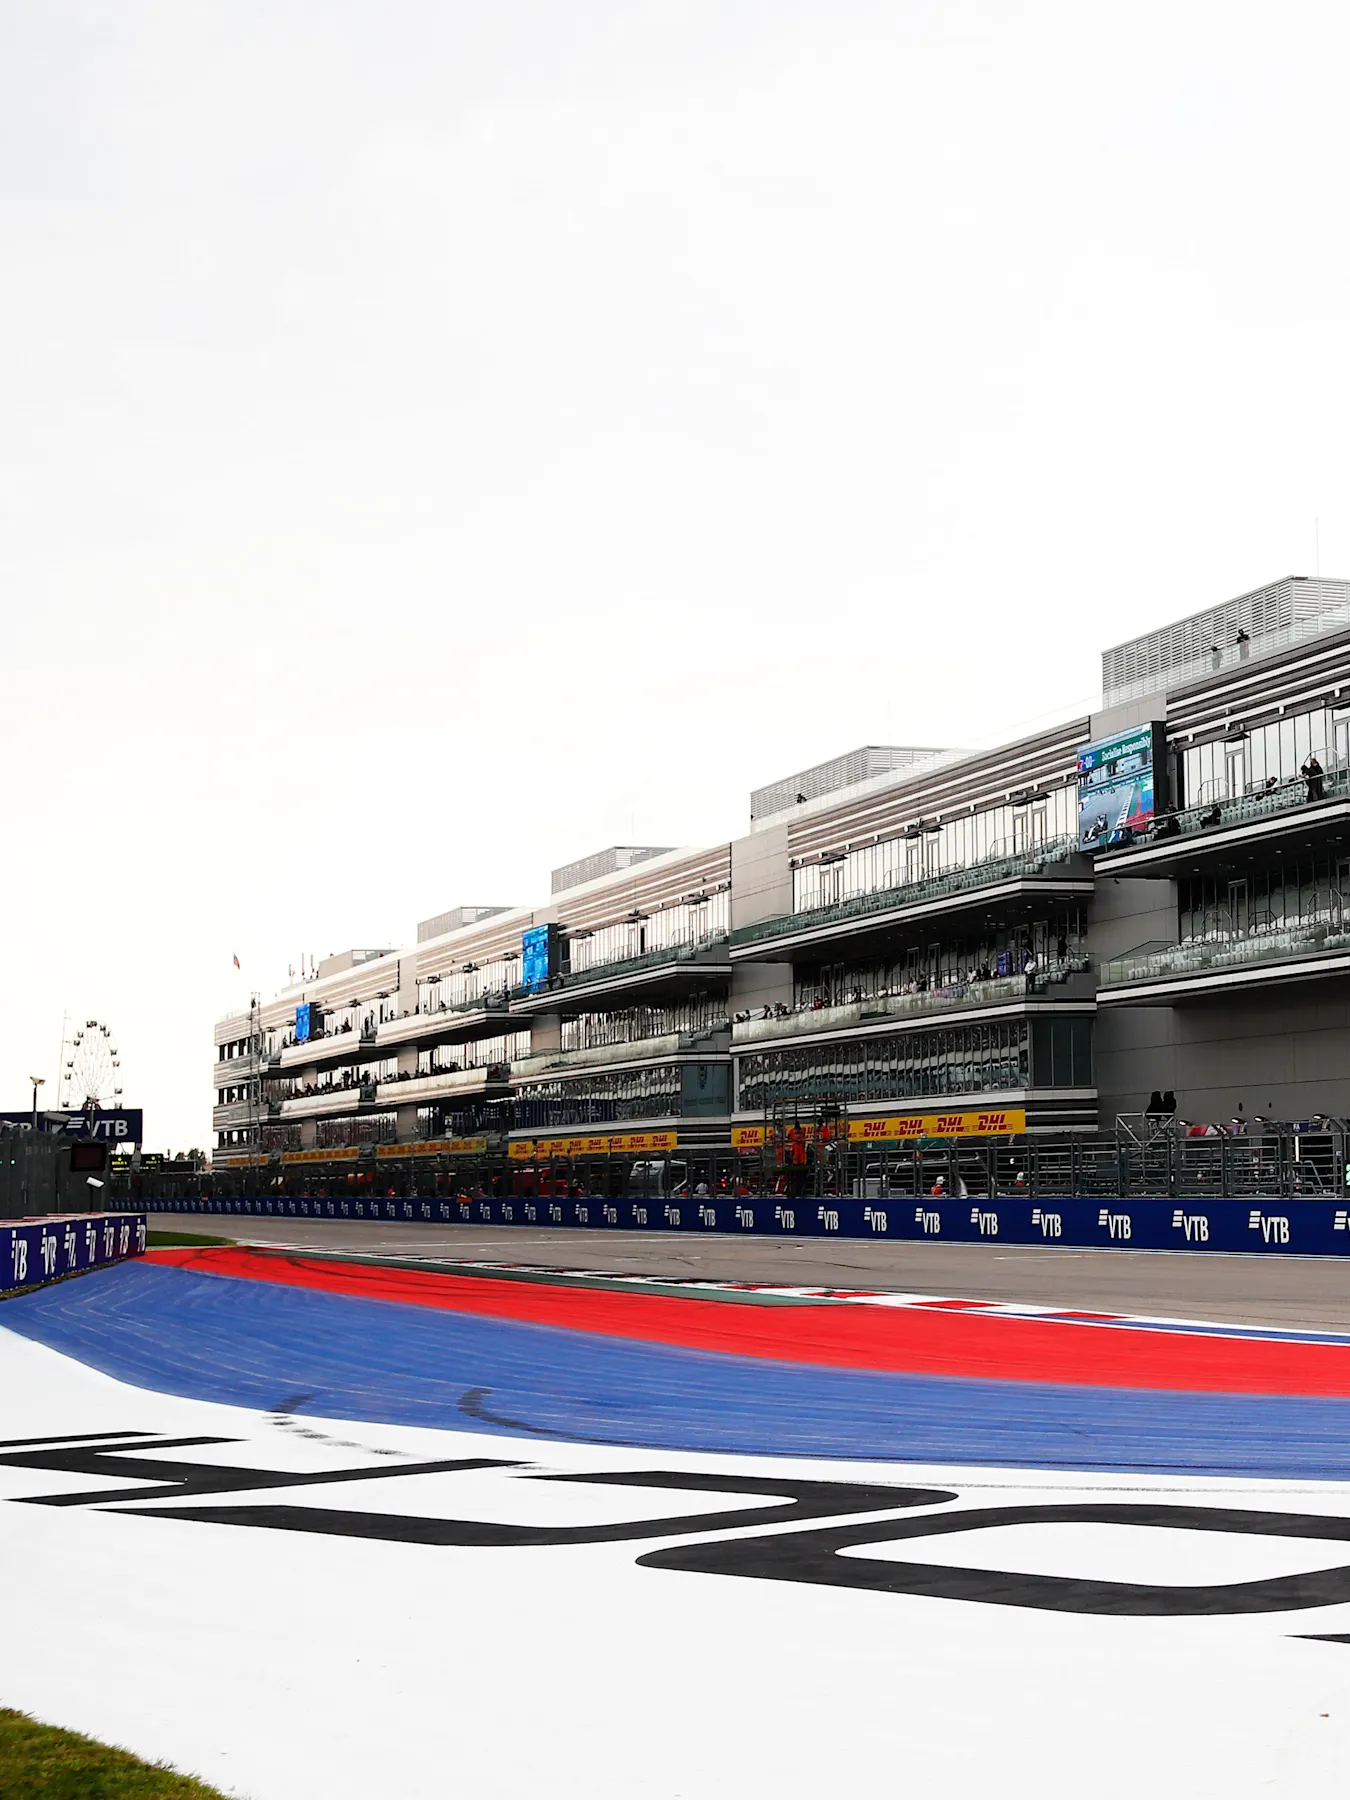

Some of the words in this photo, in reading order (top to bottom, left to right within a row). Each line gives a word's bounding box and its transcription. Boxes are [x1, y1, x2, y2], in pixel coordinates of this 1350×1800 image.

[863, 1121, 888, 1137] DHL
[899, 1119, 924, 1135] DHL
[936, 1116, 965, 1133] DHL
[978, 1114, 1008, 1131] DHL
[608, 1208, 616, 1223] VTB
[637, 1209, 647, 1224] VTB
[669, 1209, 680, 1225] VTB
[704, 1209, 715, 1226] VTB
[741, 1210, 753, 1227] VTB
[781, 1211, 794, 1228] VTB
[824, 1211, 838, 1229] VTB
[871, 1212, 886, 1231] VTB
[923, 1213, 940, 1233] VTB
[979, 1214, 998, 1234] VTB
[1041, 1214, 1061, 1236] VTB
[1109, 1215, 1131, 1238] VTB
[1183, 1216, 1208, 1241] VTB
[1261, 1217, 1289, 1243] VTB
